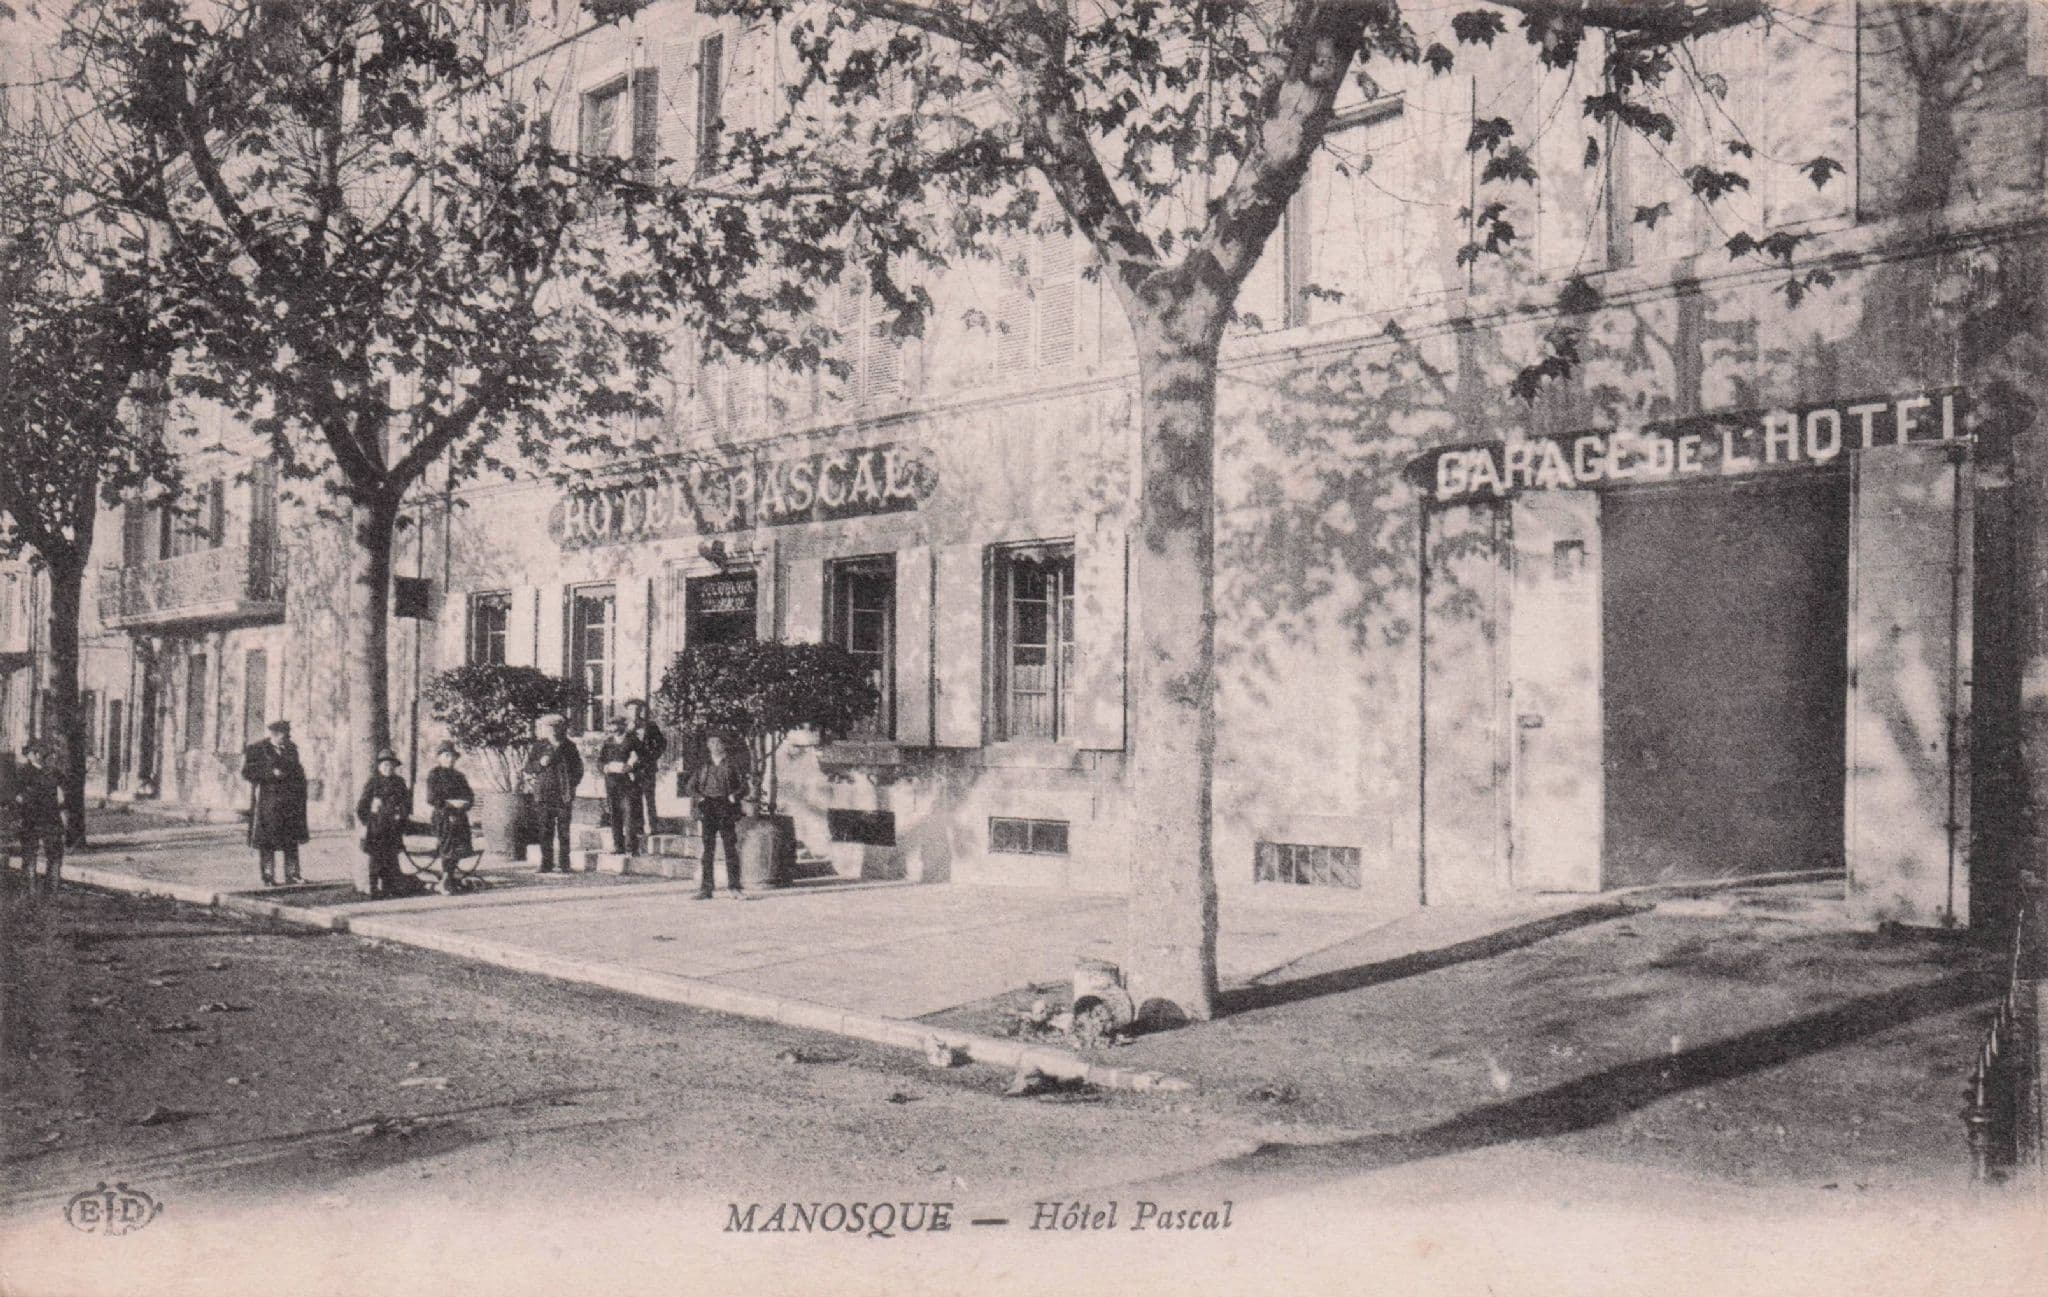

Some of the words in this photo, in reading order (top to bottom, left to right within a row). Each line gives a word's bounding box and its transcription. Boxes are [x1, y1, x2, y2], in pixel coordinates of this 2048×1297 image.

[728, 449, 916, 522] PASCAL
[1436, 432, 1639, 499] GARAGE
[1648, 434, 1702, 476] DE
